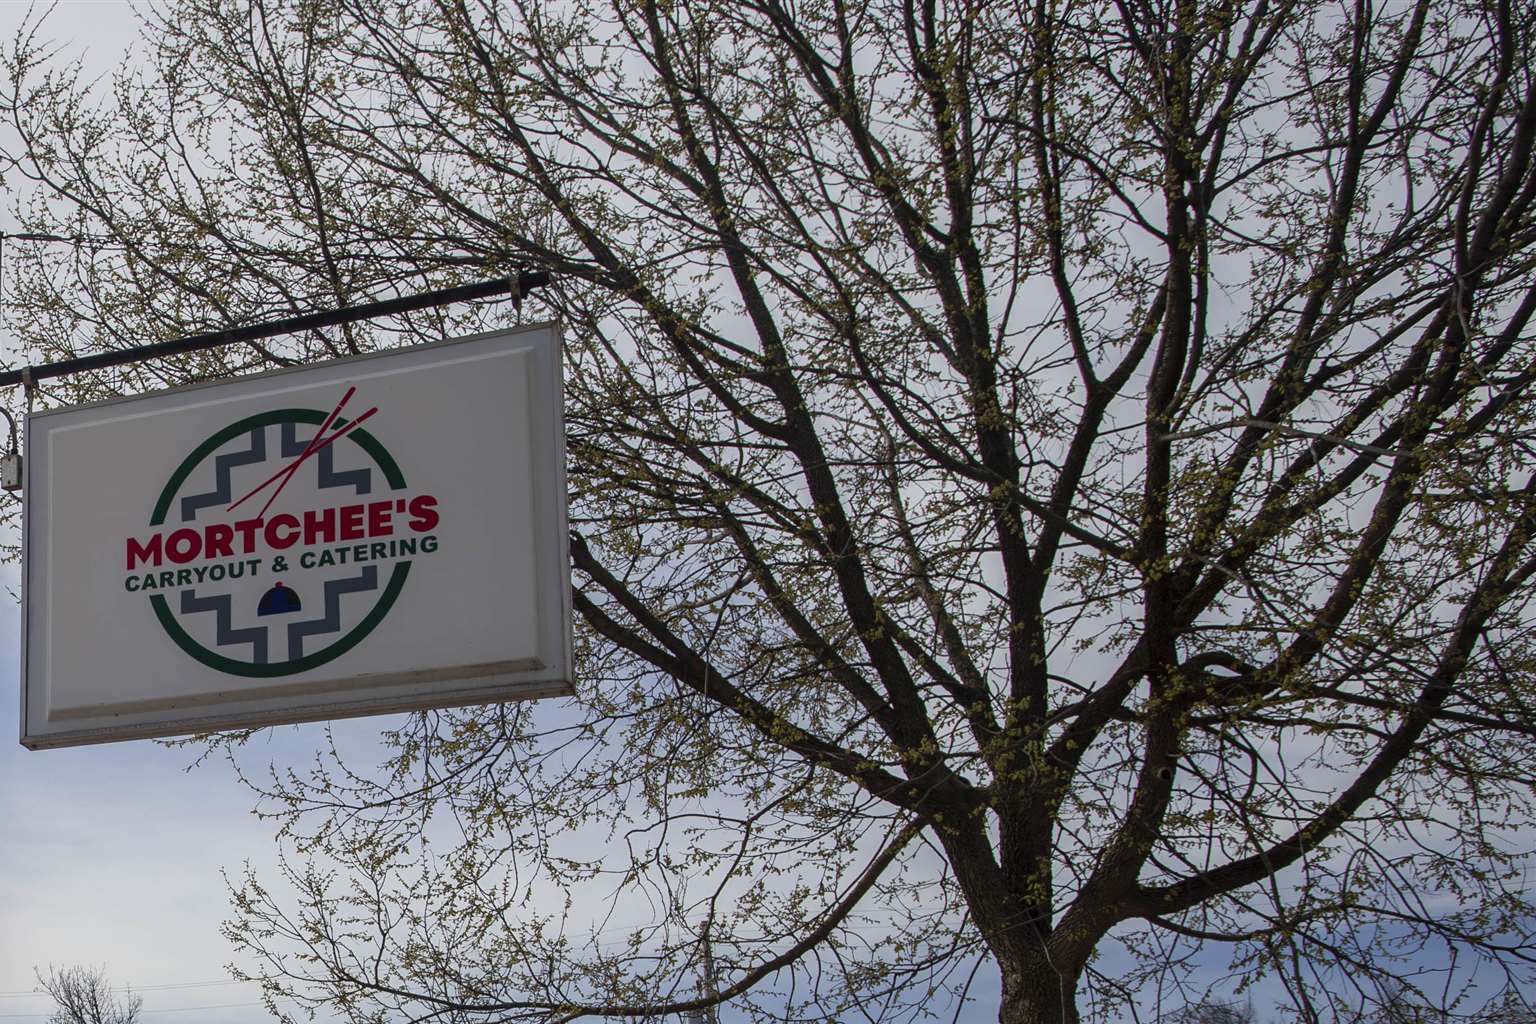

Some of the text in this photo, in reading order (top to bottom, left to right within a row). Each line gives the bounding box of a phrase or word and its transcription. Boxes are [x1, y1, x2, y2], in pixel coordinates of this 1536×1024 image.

[125, 494, 440, 571] MORTCHEE'S
[125, 535, 439, 592] CARRYOUT & CATERING
